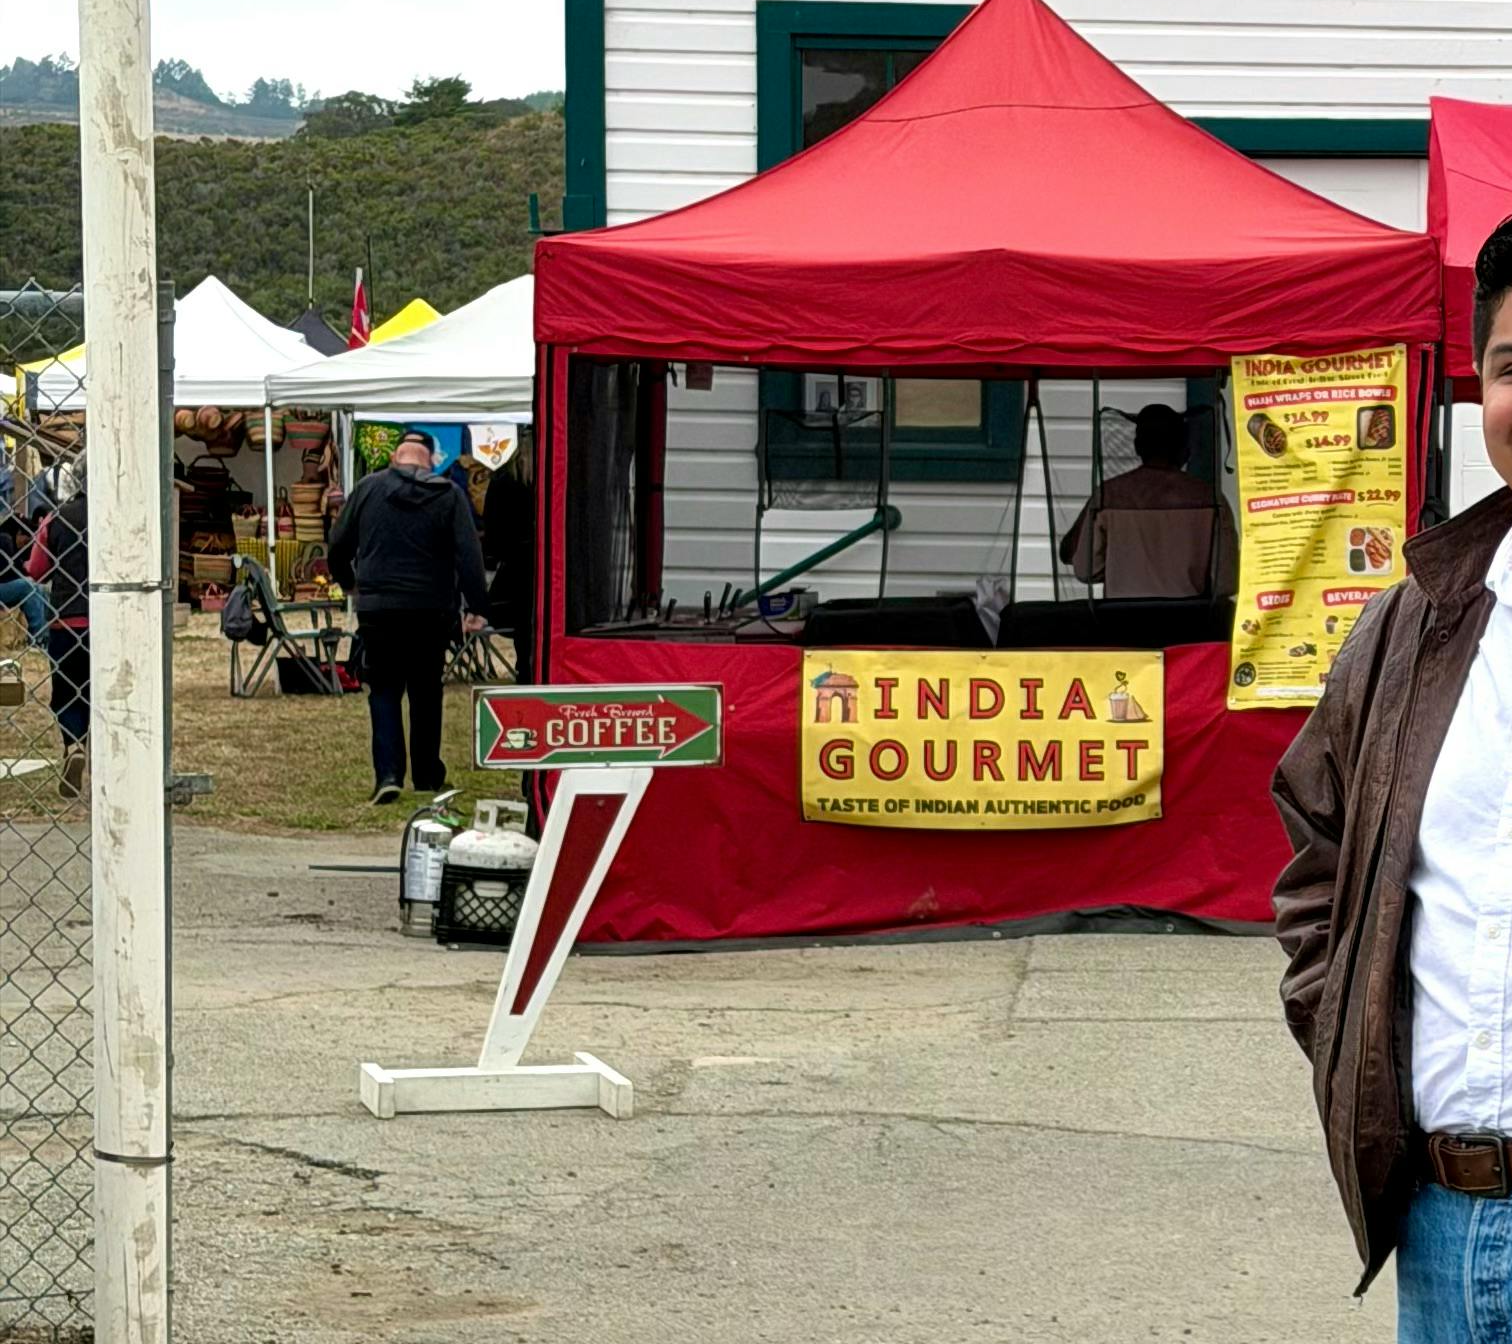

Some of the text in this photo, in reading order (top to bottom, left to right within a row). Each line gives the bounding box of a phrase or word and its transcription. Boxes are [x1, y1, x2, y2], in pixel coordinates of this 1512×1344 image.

[1244, 351, 1395, 377] INDIA GOURMET
[1275, 390, 1311, 403] WRAPS
[1313, 389, 1329, 399] OR
[1331, 388, 1356, 399] RICE
[1326, 591, 1376, 603] BEVERA
[873, 677, 1097, 721] INDIA
[546, 716, 677, 747] COFFEE
[818, 738, 1150, 782] GOURMET
[817, 793, 1147, 815] TASTE OF INDIAN AUTHENTIC FOOD
